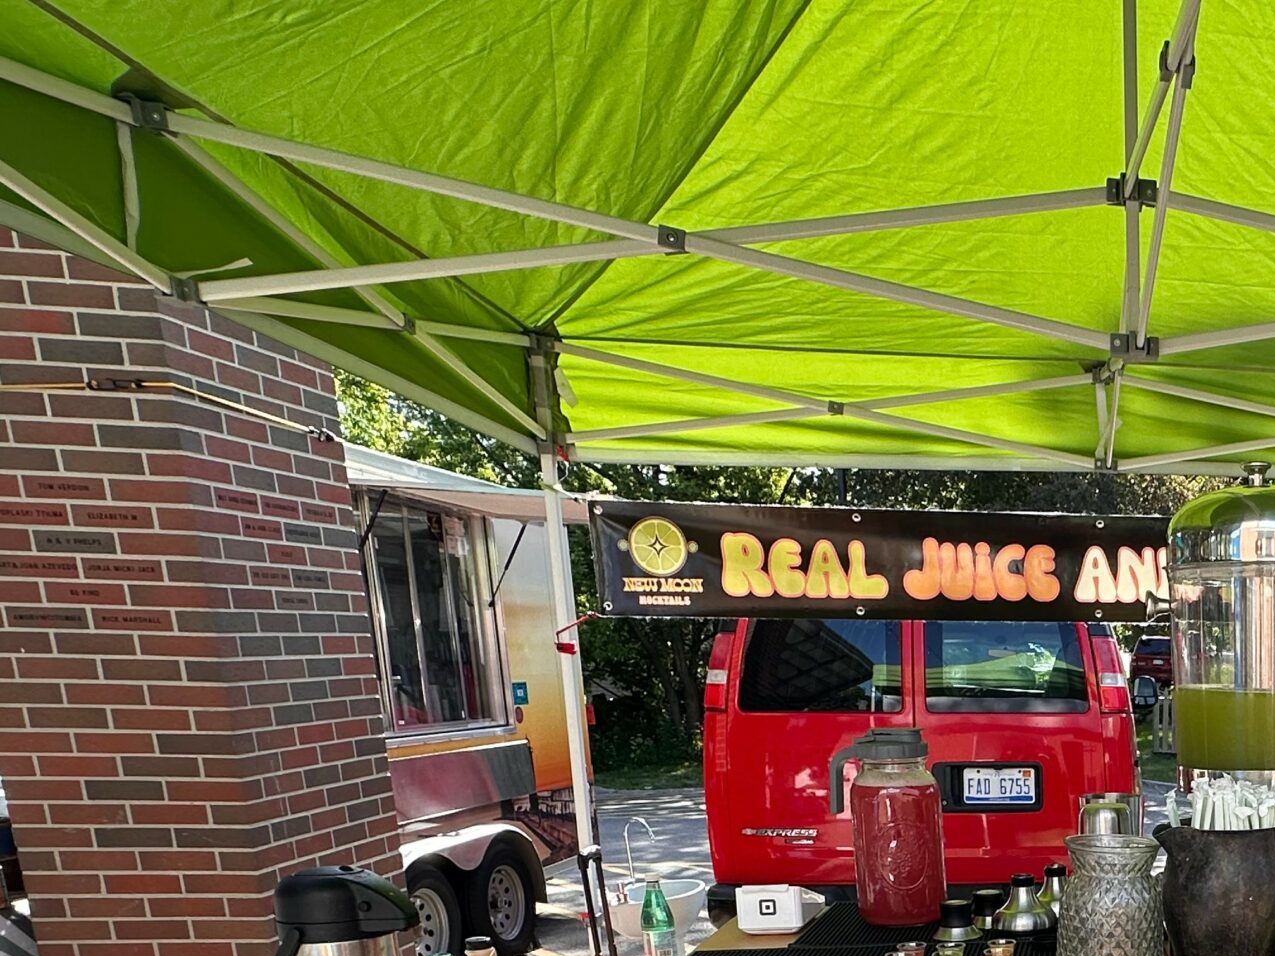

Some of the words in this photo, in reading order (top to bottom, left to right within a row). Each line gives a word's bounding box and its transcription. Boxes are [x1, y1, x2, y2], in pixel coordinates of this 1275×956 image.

[720, 532, 889, 599] REAL
[903, 537, 1057, 602] JUICE
[1074, 545, 1170, 604] AN
[622, 577, 659, 592] NEW
[660, 578, 704, 593] MOON
[968, 777, 991, 795] FAD
[1000, 777, 1031, 795] 6755
